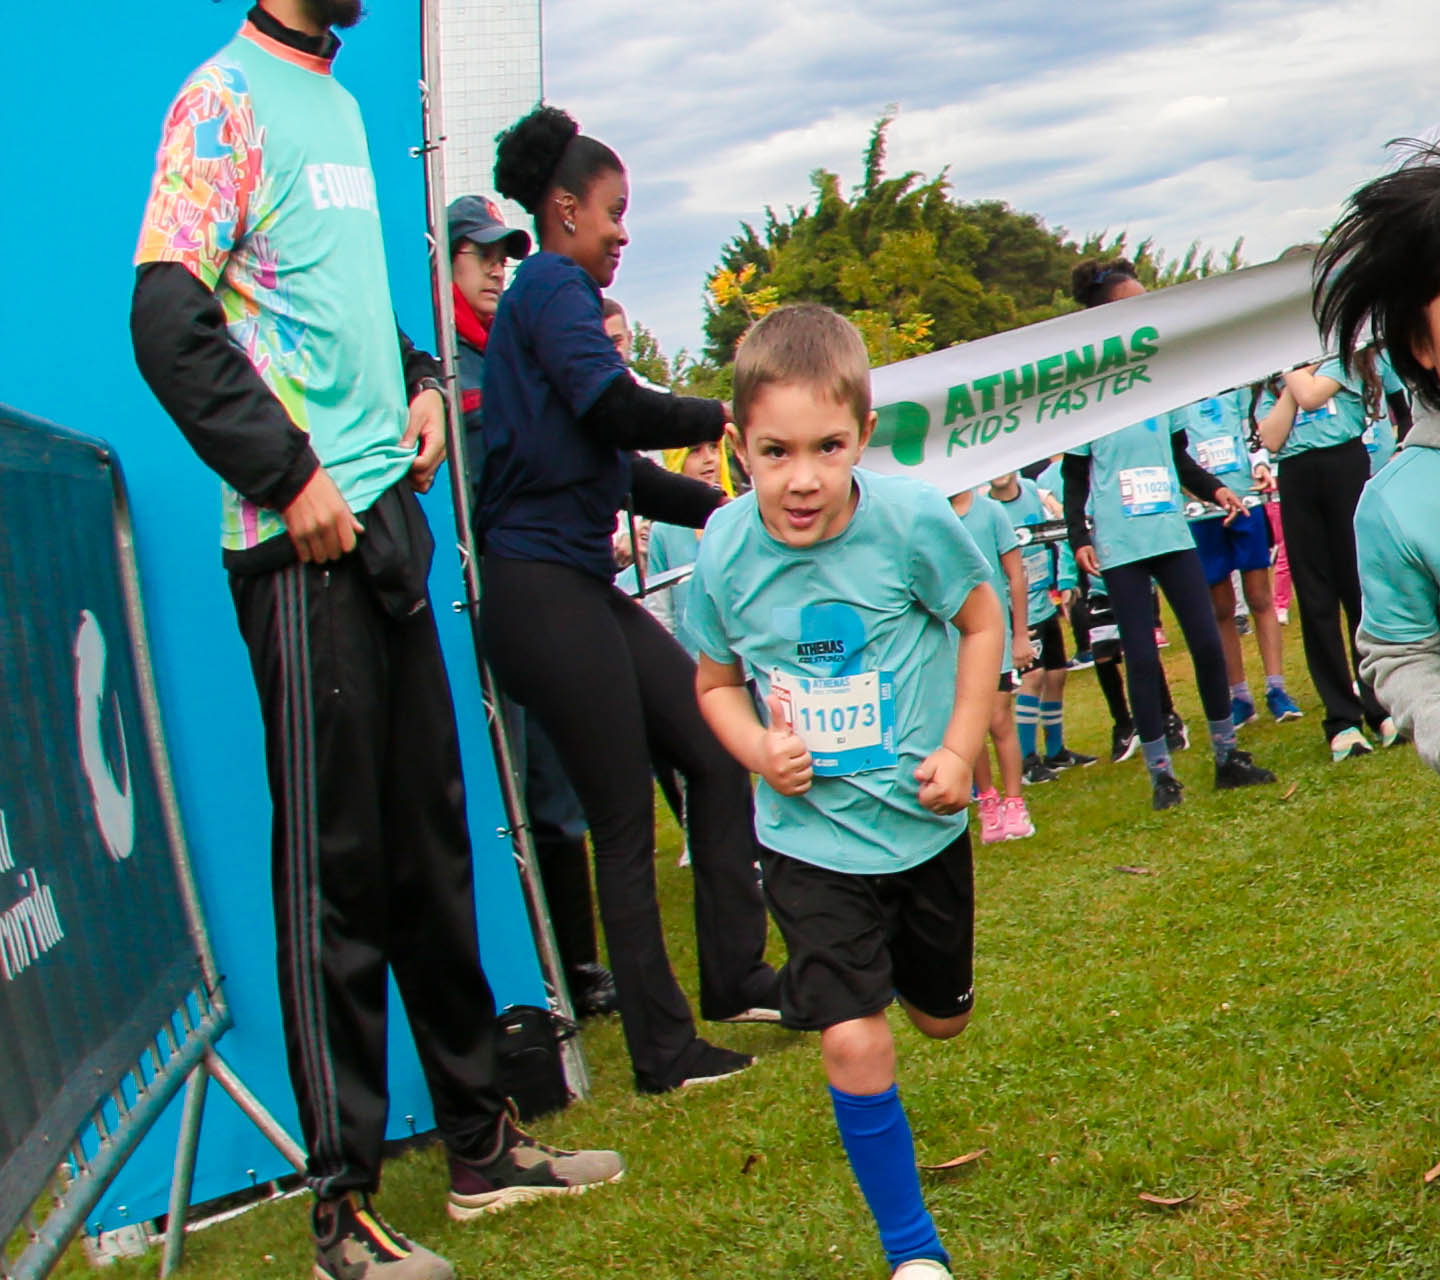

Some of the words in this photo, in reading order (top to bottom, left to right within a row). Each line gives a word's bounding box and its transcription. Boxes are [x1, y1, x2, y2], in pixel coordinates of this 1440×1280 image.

[944, 326, 1159, 425] ATHENAS
[947, 406, 1022, 457] KIDS
[1036, 364, 1152, 424] FASTER
[797, 640, 844, 656] ATHENAS
[800, 703, 875, 732] 11073
